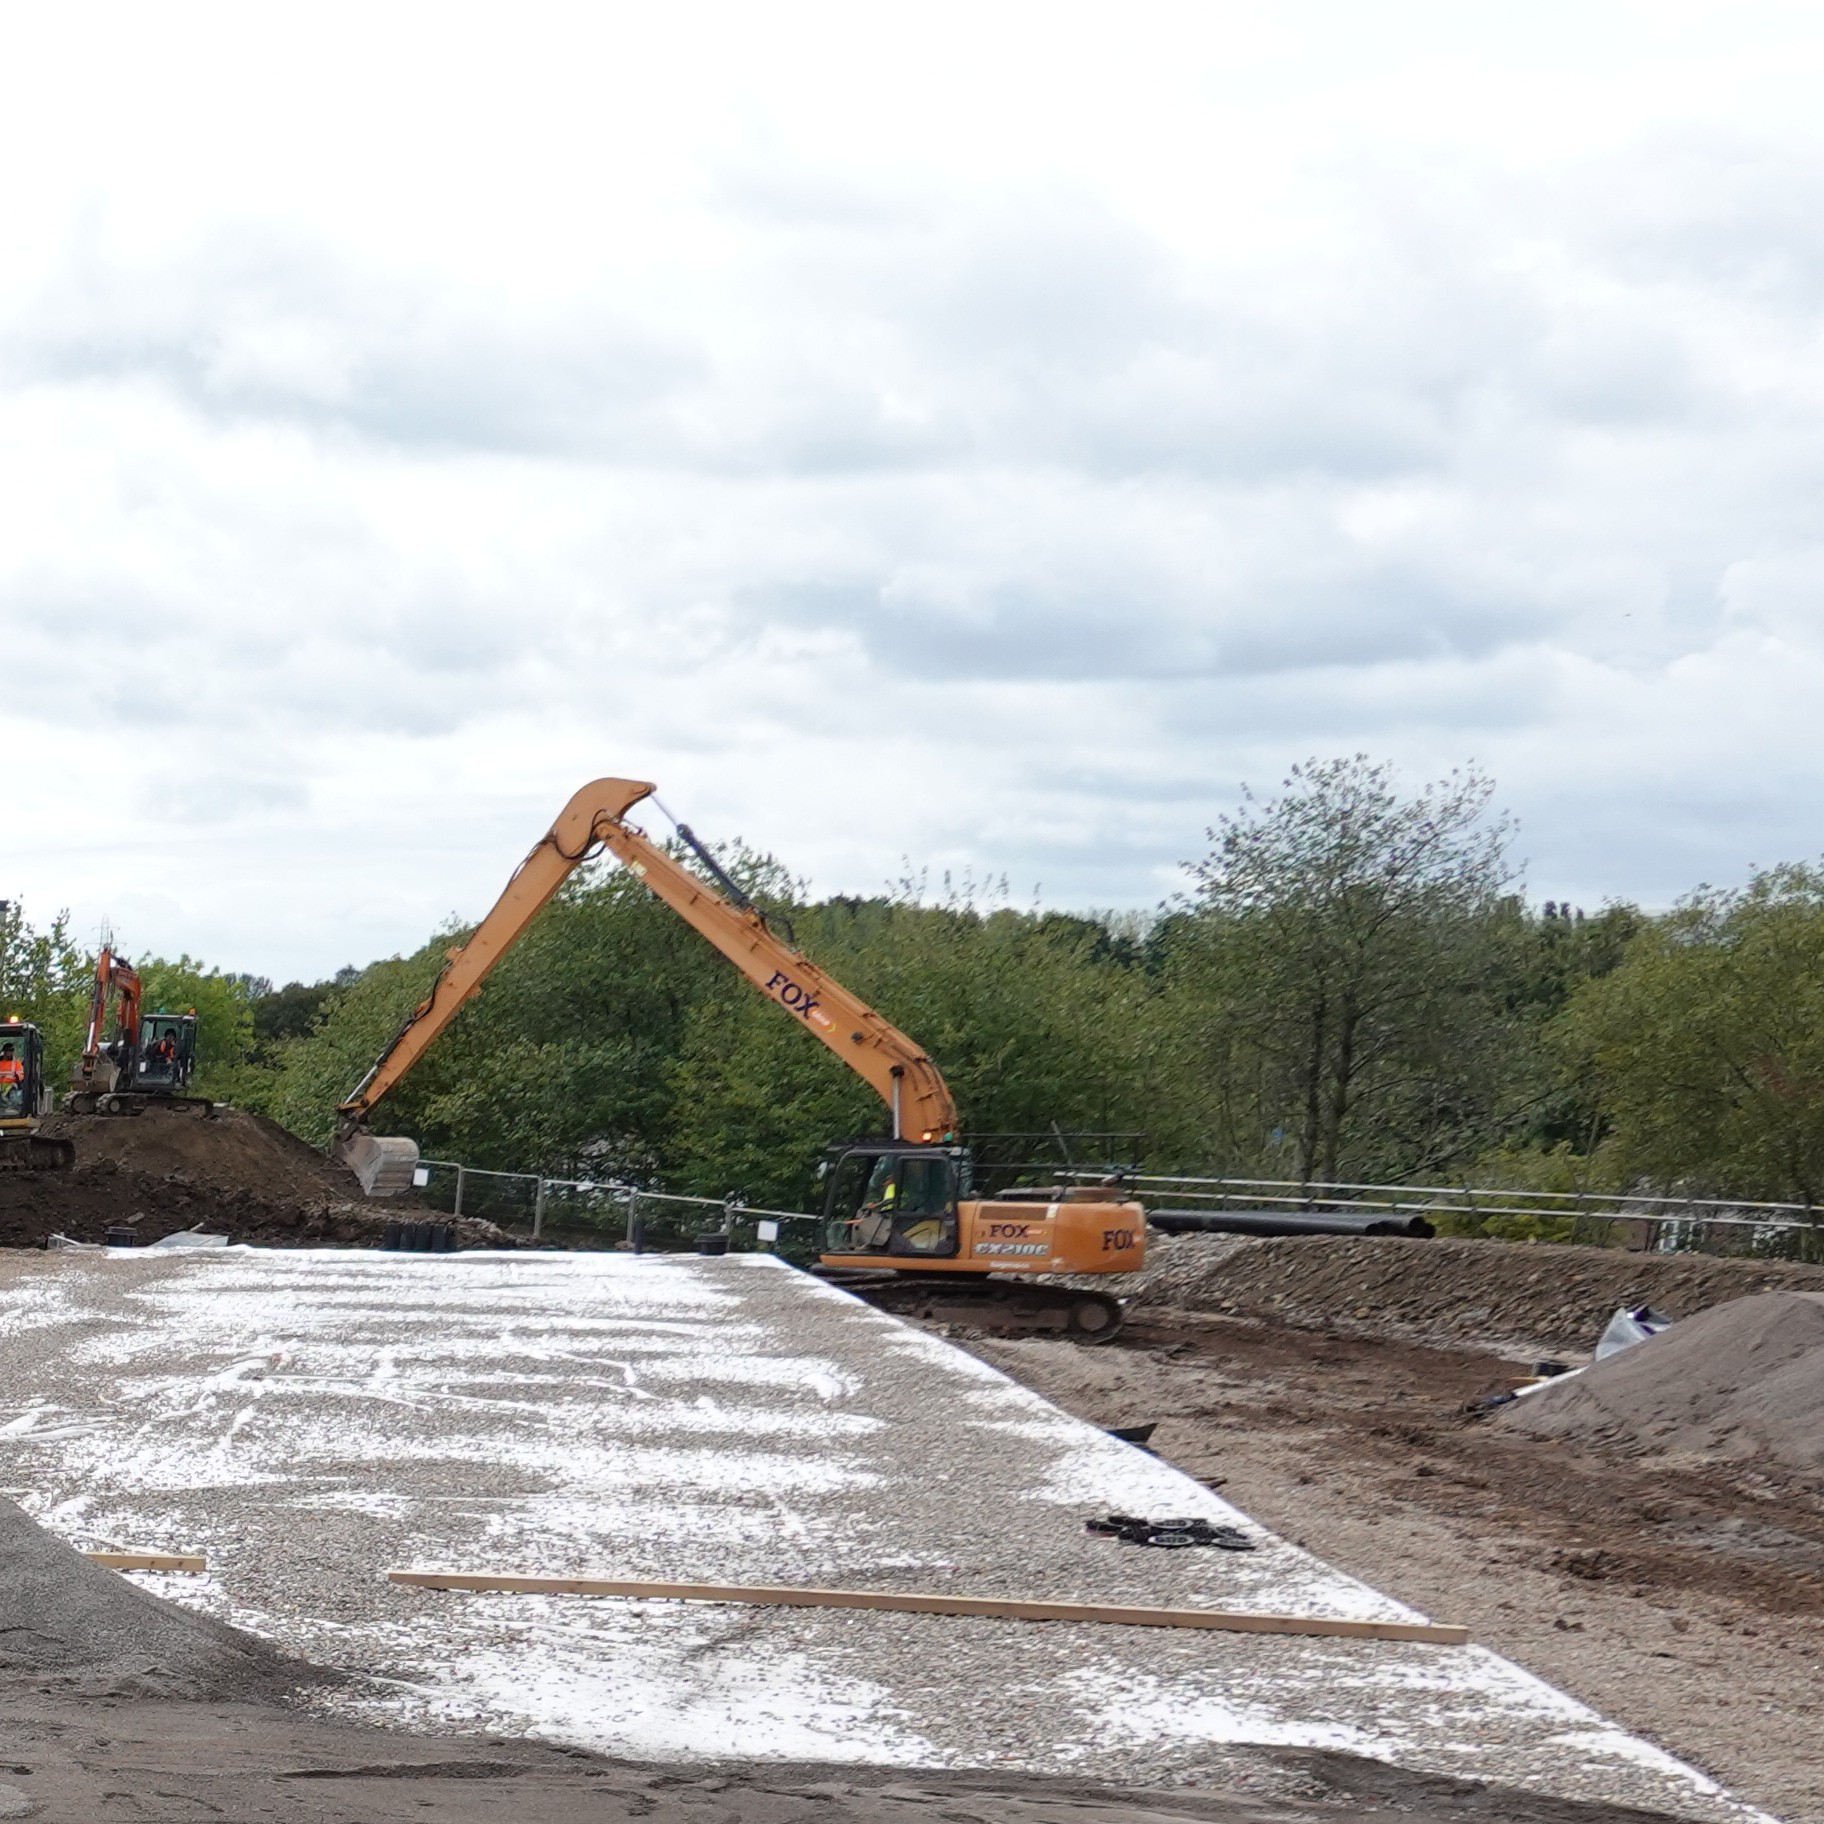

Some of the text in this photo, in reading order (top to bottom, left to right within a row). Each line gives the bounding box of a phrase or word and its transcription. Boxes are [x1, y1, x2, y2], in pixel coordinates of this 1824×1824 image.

[765, 969, 820, 1019] FOX
[990, 1224, 1030, 1238] FOX
[1102, 1229, 1136, 1251] FOX
